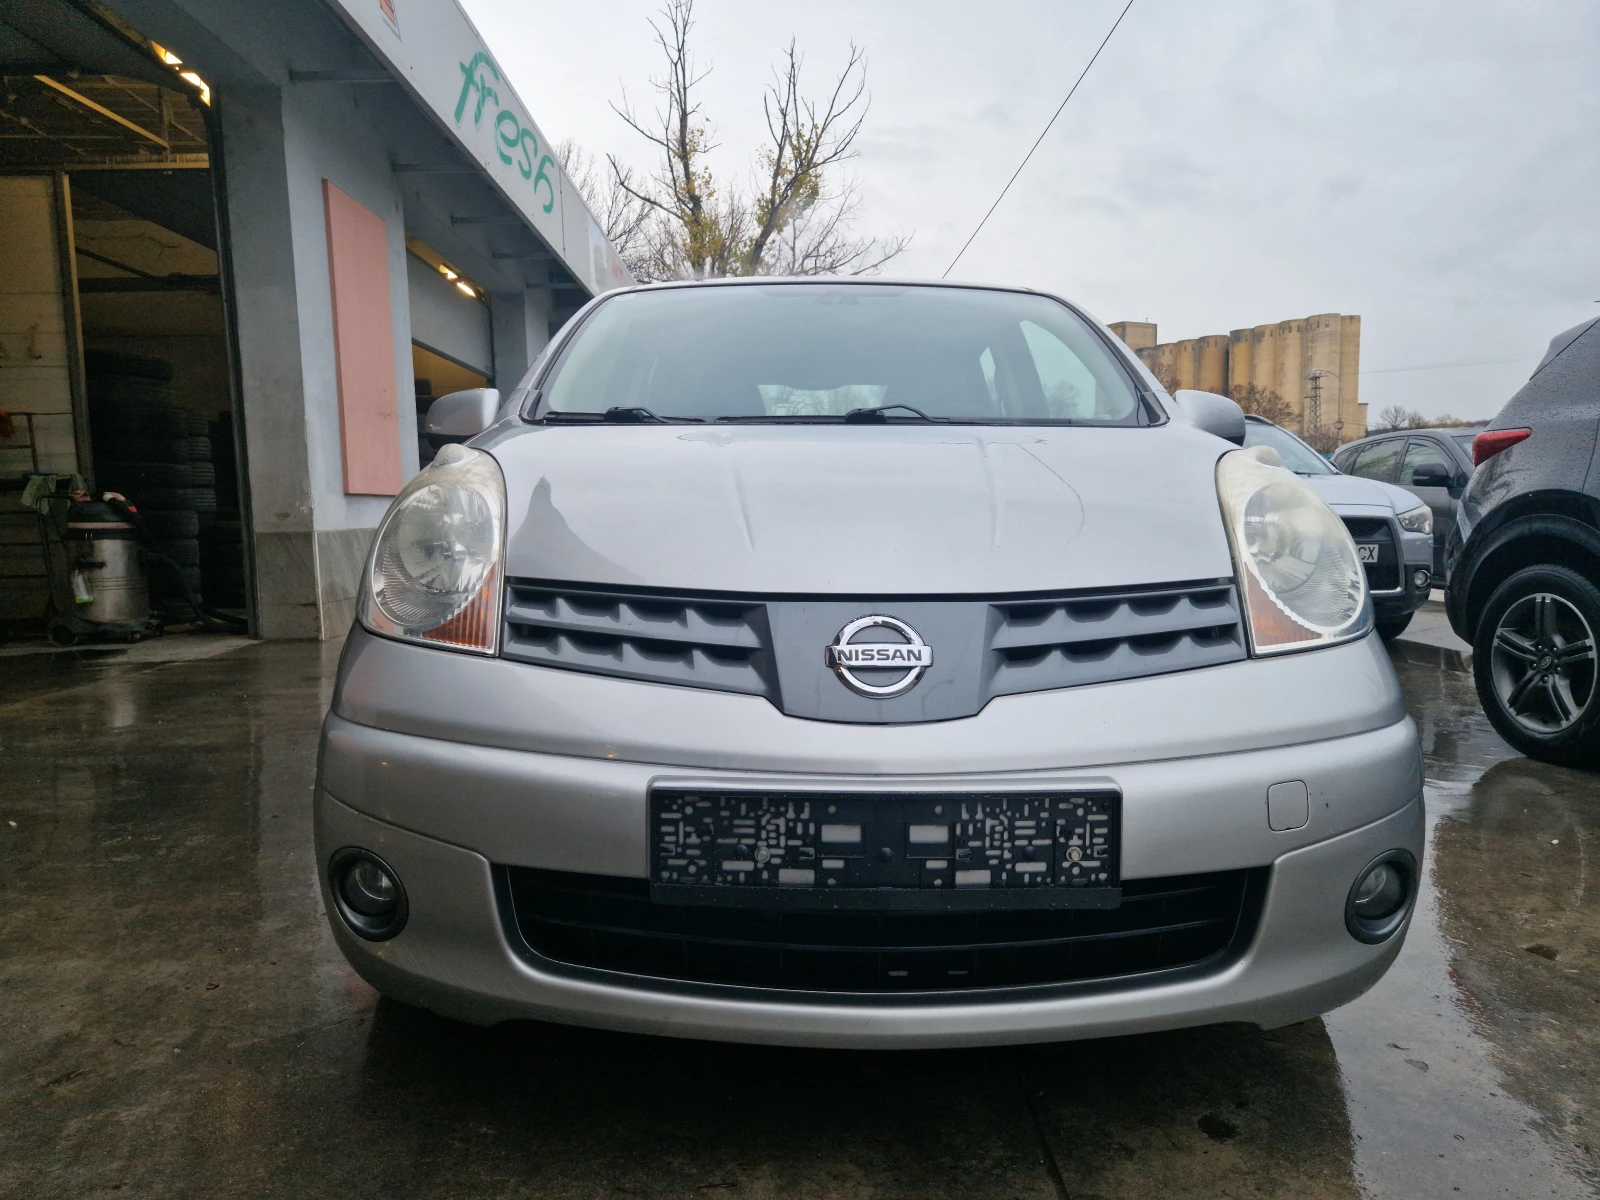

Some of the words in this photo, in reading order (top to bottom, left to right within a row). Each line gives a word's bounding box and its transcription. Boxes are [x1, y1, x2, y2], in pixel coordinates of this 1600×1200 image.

[454, 52, 554, 214] fresh
[1358, 546, 1376, 560] CX
[837, 648, 922, 662] NISSAN
